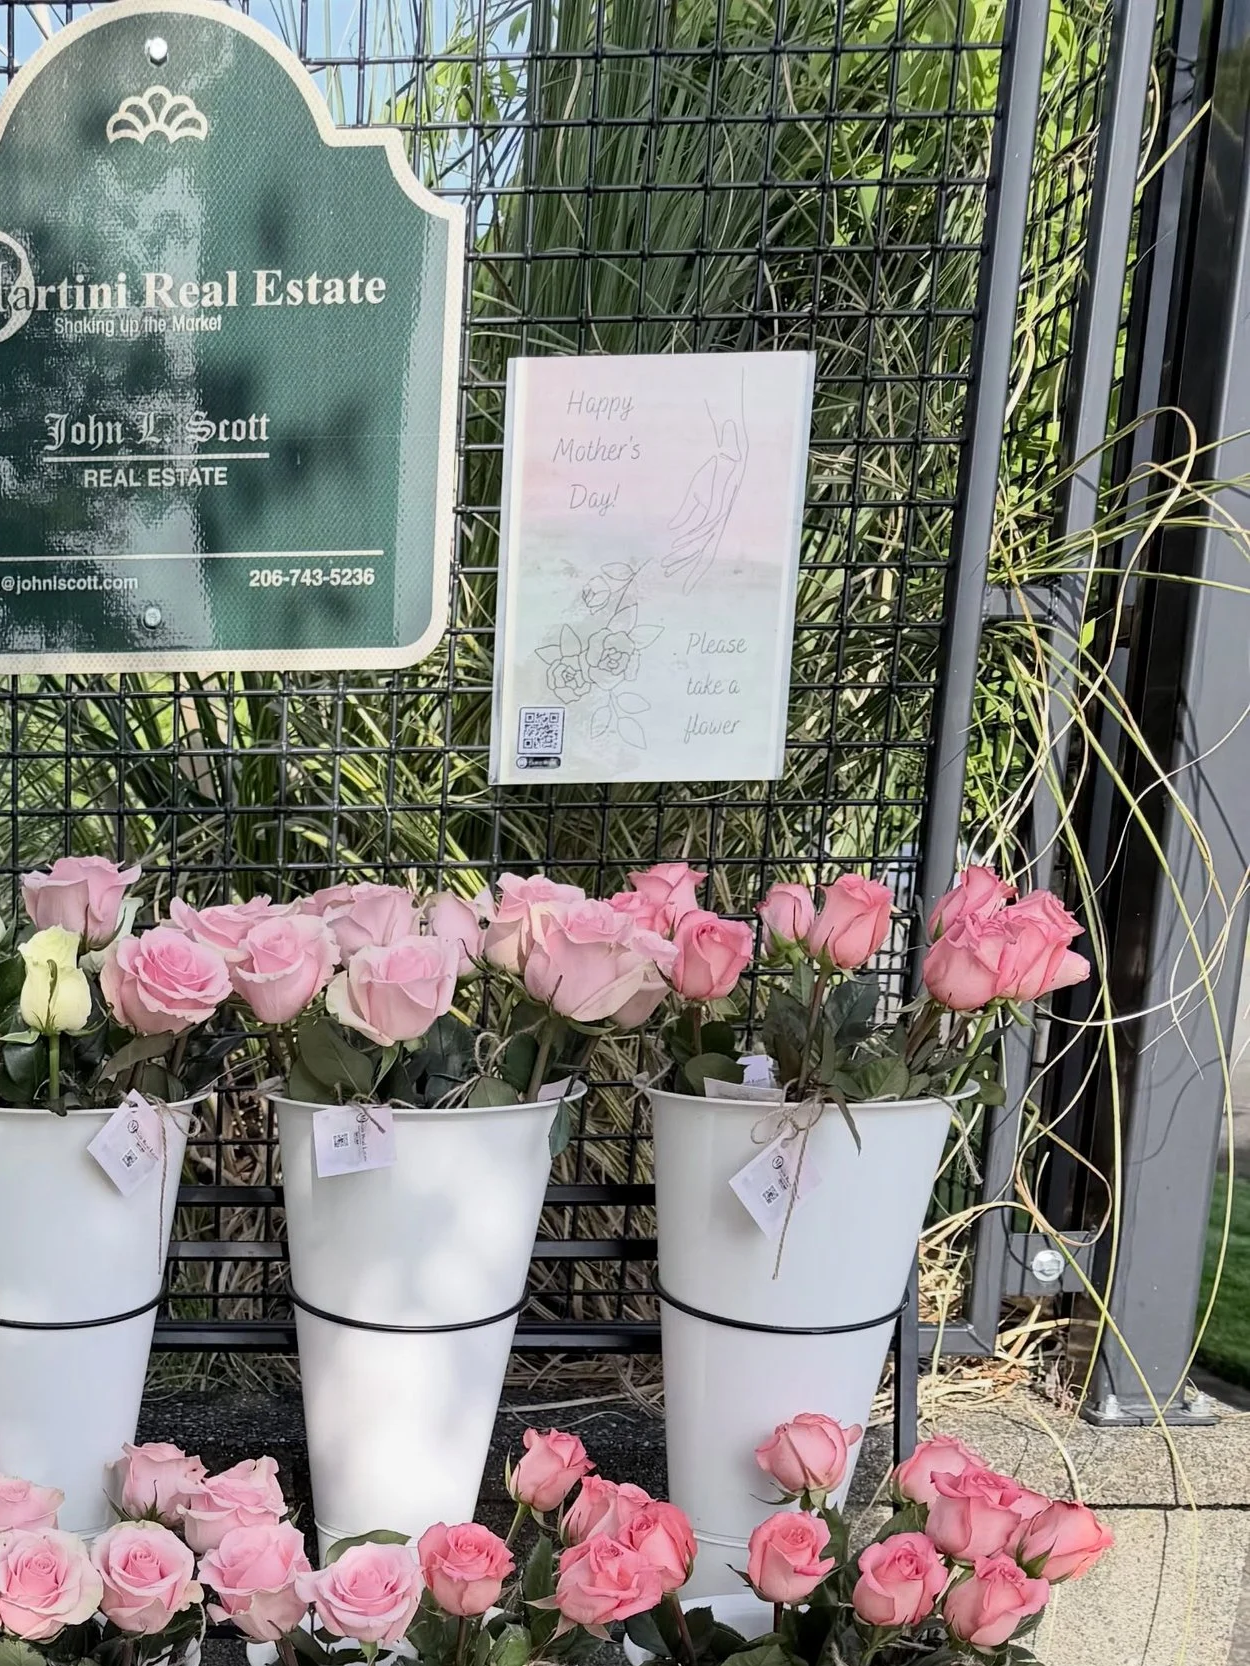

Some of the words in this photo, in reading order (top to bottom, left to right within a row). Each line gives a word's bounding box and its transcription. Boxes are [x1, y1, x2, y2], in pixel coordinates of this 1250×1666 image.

[142, 271, 239, 309] Real
[252, 269, 387, 306] Estate
[55, 317, 115, 338] Shaking
[120, 319, 139, 338] up
[142, 317, 166, 333] the
[172, 314, 222, 333] Market
[567, 390, 634, 421] Happy
[44, 412, 125, 451] John
[136, 411, 171, 445] L.
[185, 410, 271, 444] Scott
[553, 435, 641, 463] Mother's
[84, 468, 142, 488] REAL
[148, 466, 228, 487] ESTATE
[569, 483, 620, 516] Day!
[249, 568, 375, 587] 206-743-5236
[686, 631, 747, 655] Please
[687, 673, 724, 695] take
[728, 679, 741, 695] a
[683, 713, 741, 744] flower
